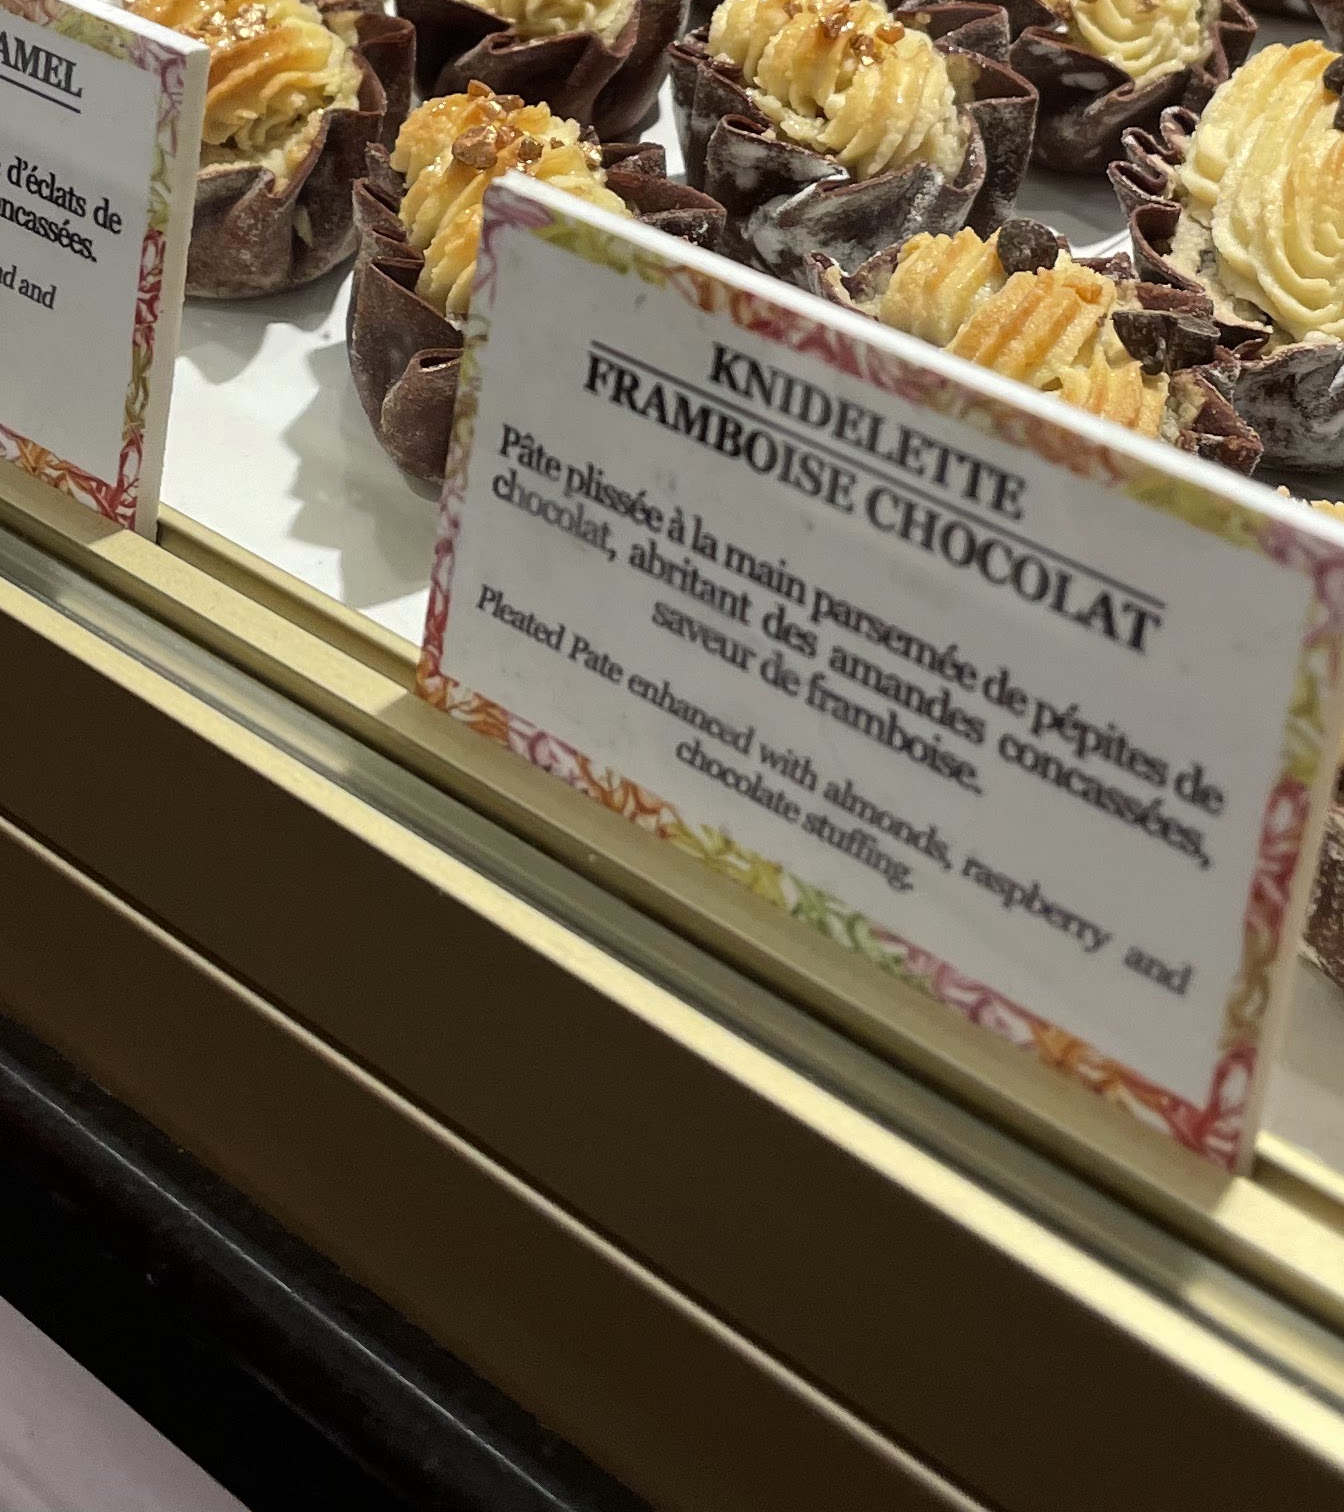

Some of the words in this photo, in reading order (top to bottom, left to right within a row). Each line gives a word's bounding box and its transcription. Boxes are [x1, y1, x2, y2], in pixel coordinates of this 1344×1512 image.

[19, 278, 56, 309] and
[93, 197, 122, 234] de
[584, 355, 858, 514] FRAMBOISE
[864, 486, 1162, 655] CHOCOLAT
[708, 341, 1026, 520] KNIDELETTE
[492, 467, 616, 562] chocolat,
[629, 539, 753, 627] abritant
[762, 603, 817, 658] des
[828, 645, 985, 743] amandes
[998, 733, 1210, 871] concassées,
[499, 423, 561, 482] Pâte
[564, 462, 664, 533] plissée
[667, 504, 685, 545] à
[691, 514, 717, 562] la
[724, 543, 806, 607] main
[810, 587, 978, 690] parsemée
[982, 666, 1030, 717] de
[1031, 696, 1169, 788] pépites
[1174, 761, 1226, 816] de
[652, 601, 757, 672] saveur
[760, 649, 801, 697] de
[805, 671, 983, 796] framboise.
[476, 584, 566, 653] Pleated
[568, 632, 624, 684] Pate
[627, 674, 755, 756] enhanced
[759, 741, 819, 791] with
[823, 779, 952, 871] almonds,
[961, 857, 1113, 954] raspberry
[1123, 945, 1193, 995] and
[675, 739, 801, 823] chocolate
